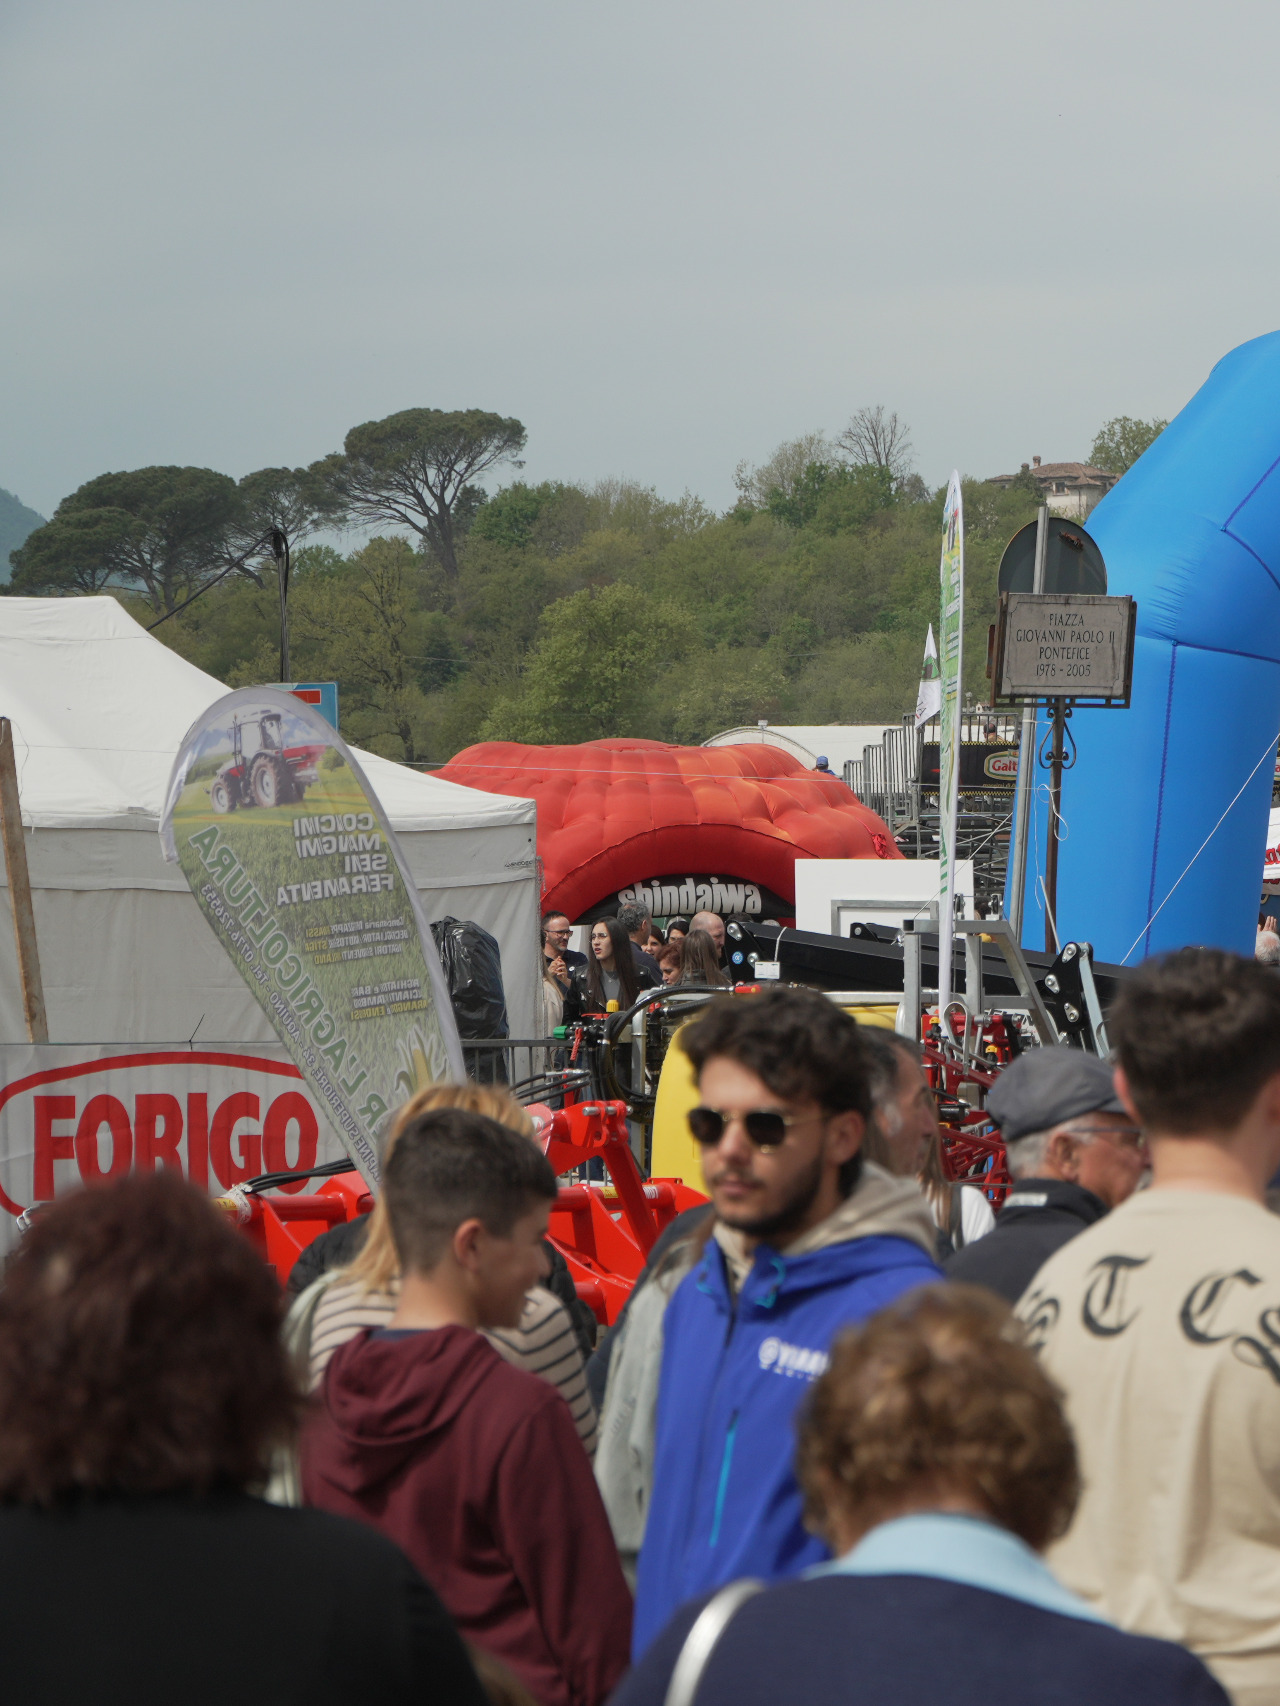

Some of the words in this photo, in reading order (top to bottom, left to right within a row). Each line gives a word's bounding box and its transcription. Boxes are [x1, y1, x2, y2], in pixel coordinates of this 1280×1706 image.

[1049, 613, 1085, 626] PIAZZA
[1016, 629, 1066, 643] GIOVANNI
[1071, 630, 1104, 643] PAOLO
[1109, 631, 1116, 644] II
[1039, 647, 1090, 660] PONTEFICE
[1036, 664, 1056, 677] 1978
[1066, 664, 1091, 677] 2005
[33, 1091, 319, 1202] FORIGO
